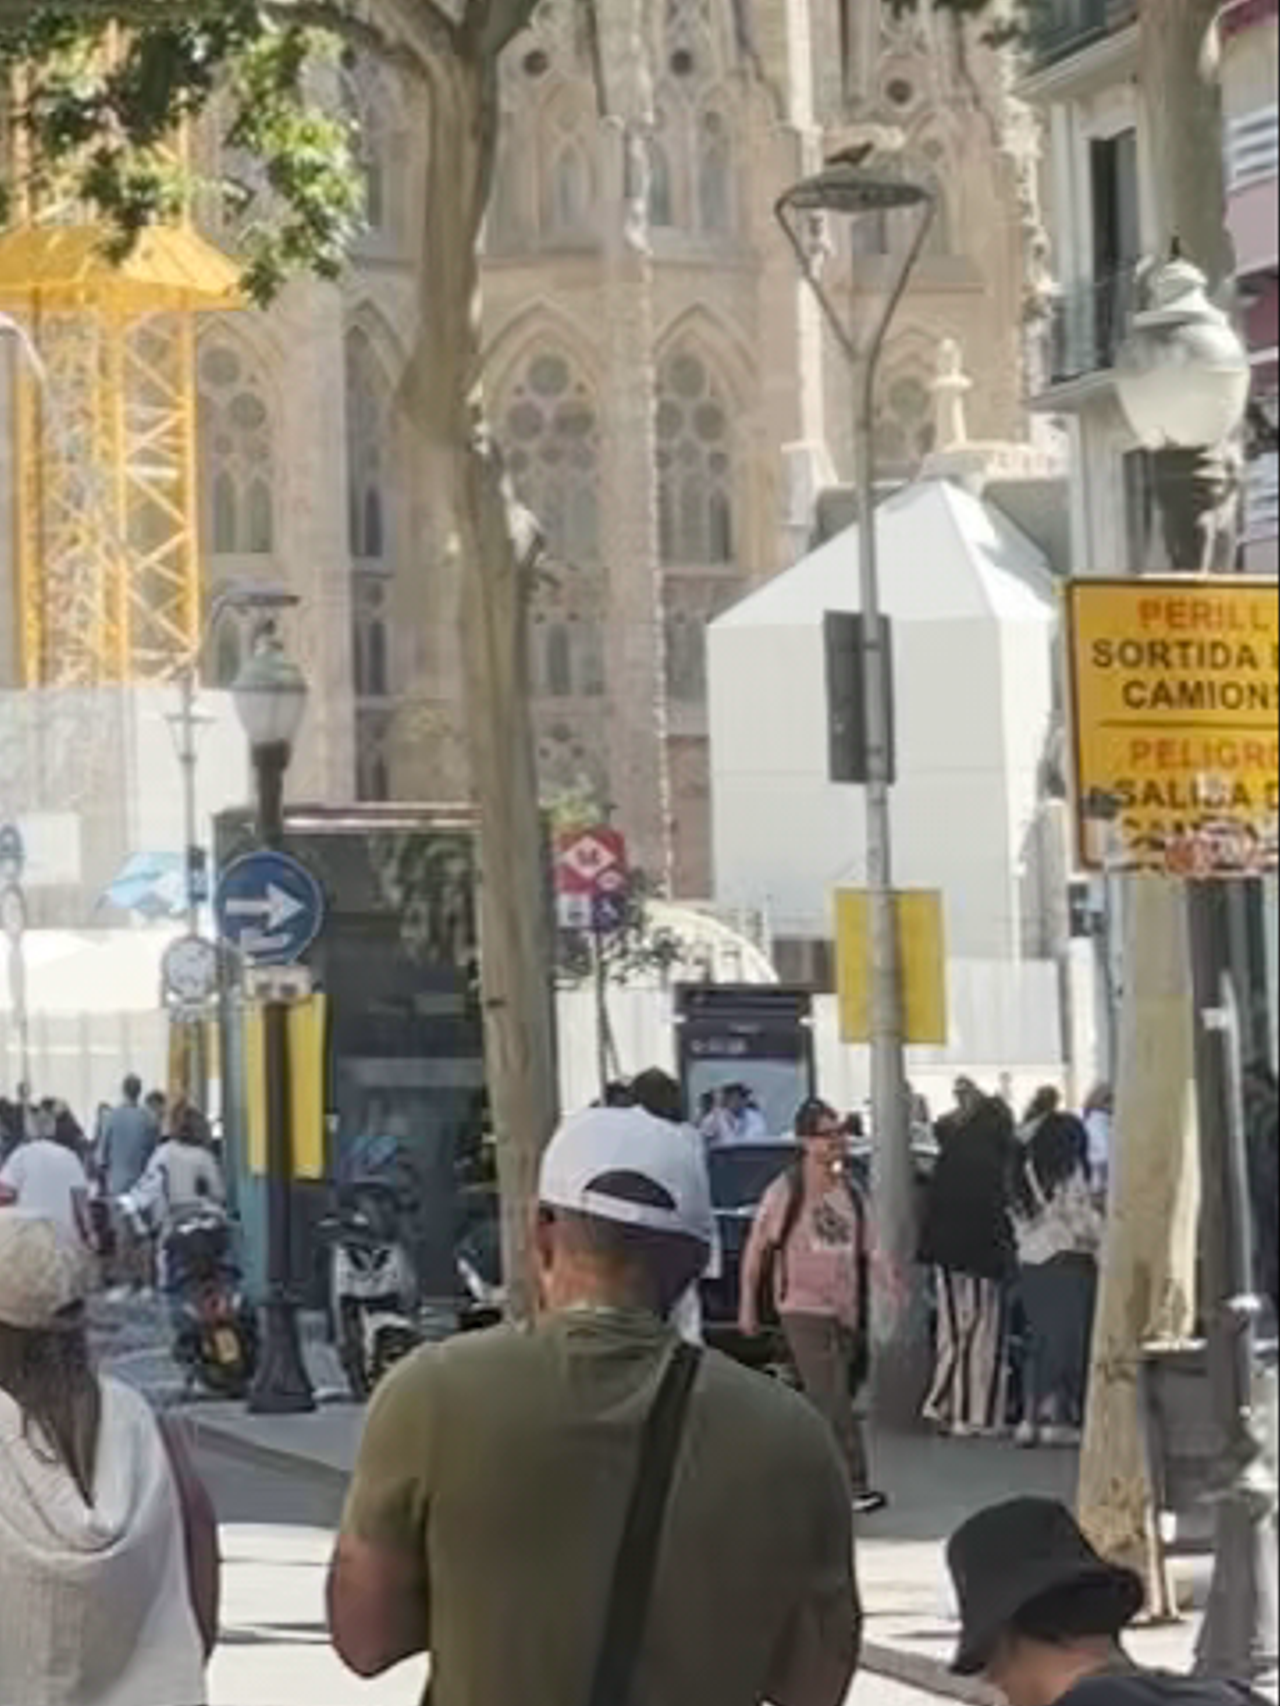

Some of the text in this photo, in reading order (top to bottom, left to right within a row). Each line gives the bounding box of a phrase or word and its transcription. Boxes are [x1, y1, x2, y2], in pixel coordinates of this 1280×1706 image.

[1137, 599, 1269, 631] PERILL
[1092, 638, 1258, 670] SORTIDA
[1122, 679, 1278, 710] CAMION
[1130, 739, 1278, 770] PELIGR
